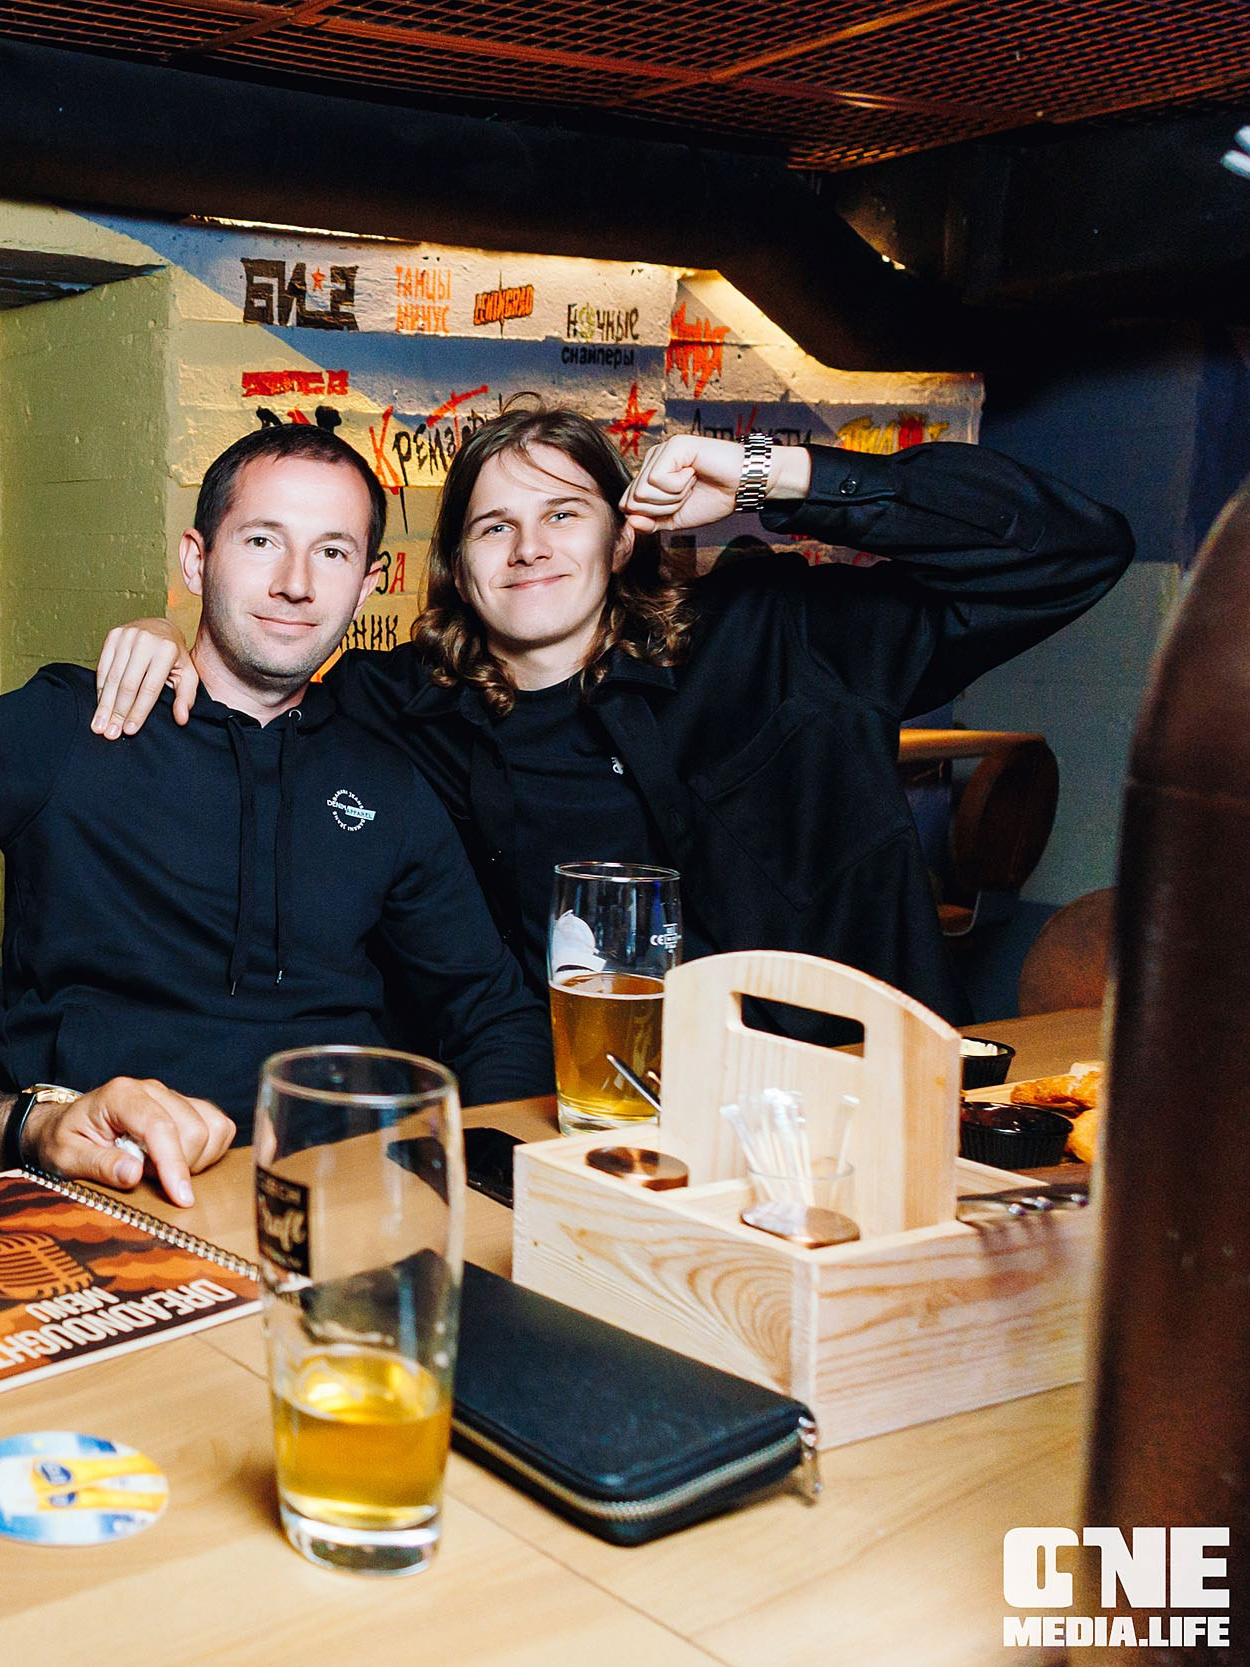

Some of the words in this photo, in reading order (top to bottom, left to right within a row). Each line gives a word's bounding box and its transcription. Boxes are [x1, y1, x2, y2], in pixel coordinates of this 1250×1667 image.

[395, 265, 451, 303] ТАНЦЫ
[395, 304, 451, 333] МИНУС
[338, 614, 399, 653] НИК
[25, 1285, 120, 1321] MENU
